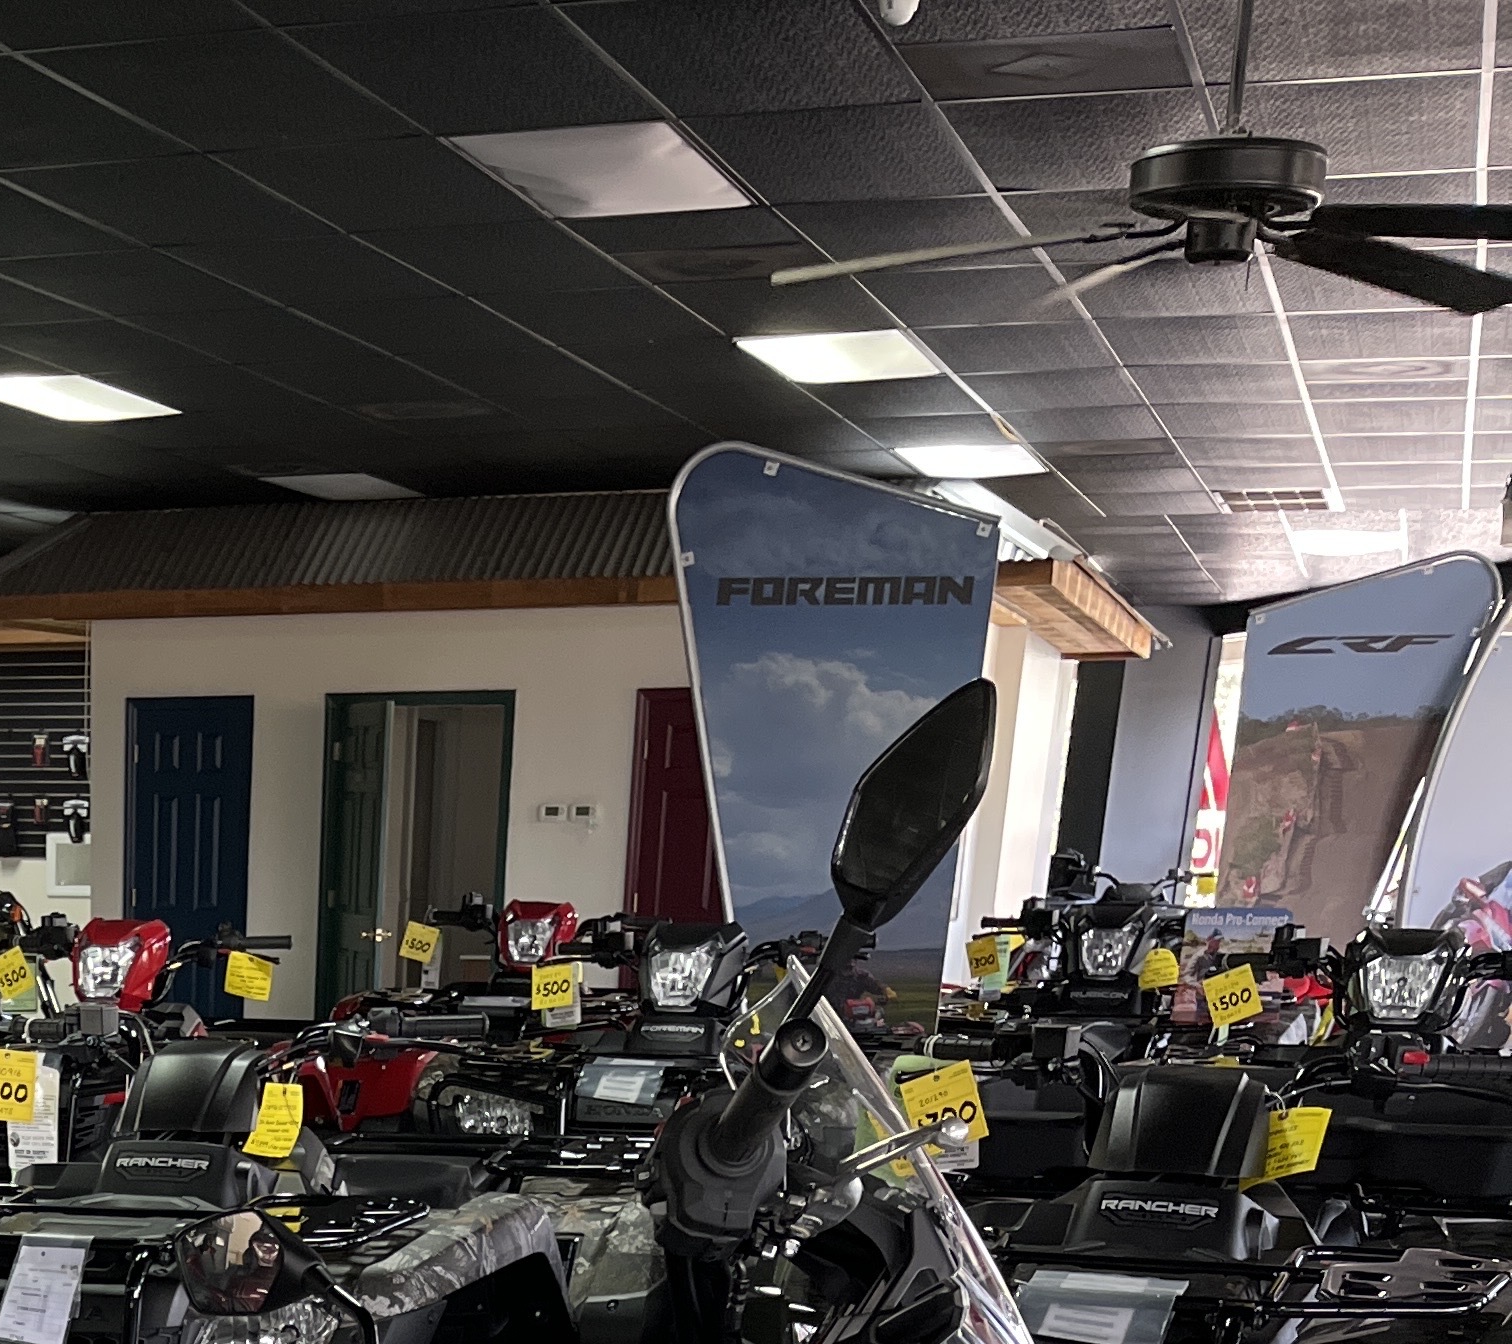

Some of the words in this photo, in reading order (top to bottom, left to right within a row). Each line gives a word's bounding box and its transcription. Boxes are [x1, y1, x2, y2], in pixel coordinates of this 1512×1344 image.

[716, 576, 975, 606] FOREMAN
[1267, 634, 1455, 655] CRF
[1191, 912, 1224, 926] Honda
[405, 938, 431, 953] $500
[0, 966, 27, 988] $500
[535, 979, 571, 998] $500
[1070, 991, 1129, 1000] RUBICON
[1212, 987, 1252, 1012] $500
[641, 1025, 705, 1034] FOREMAN
[116, 1157, 209, 1170] RANCHER
[1100, 1199, 1219, 1218] RANCHER
